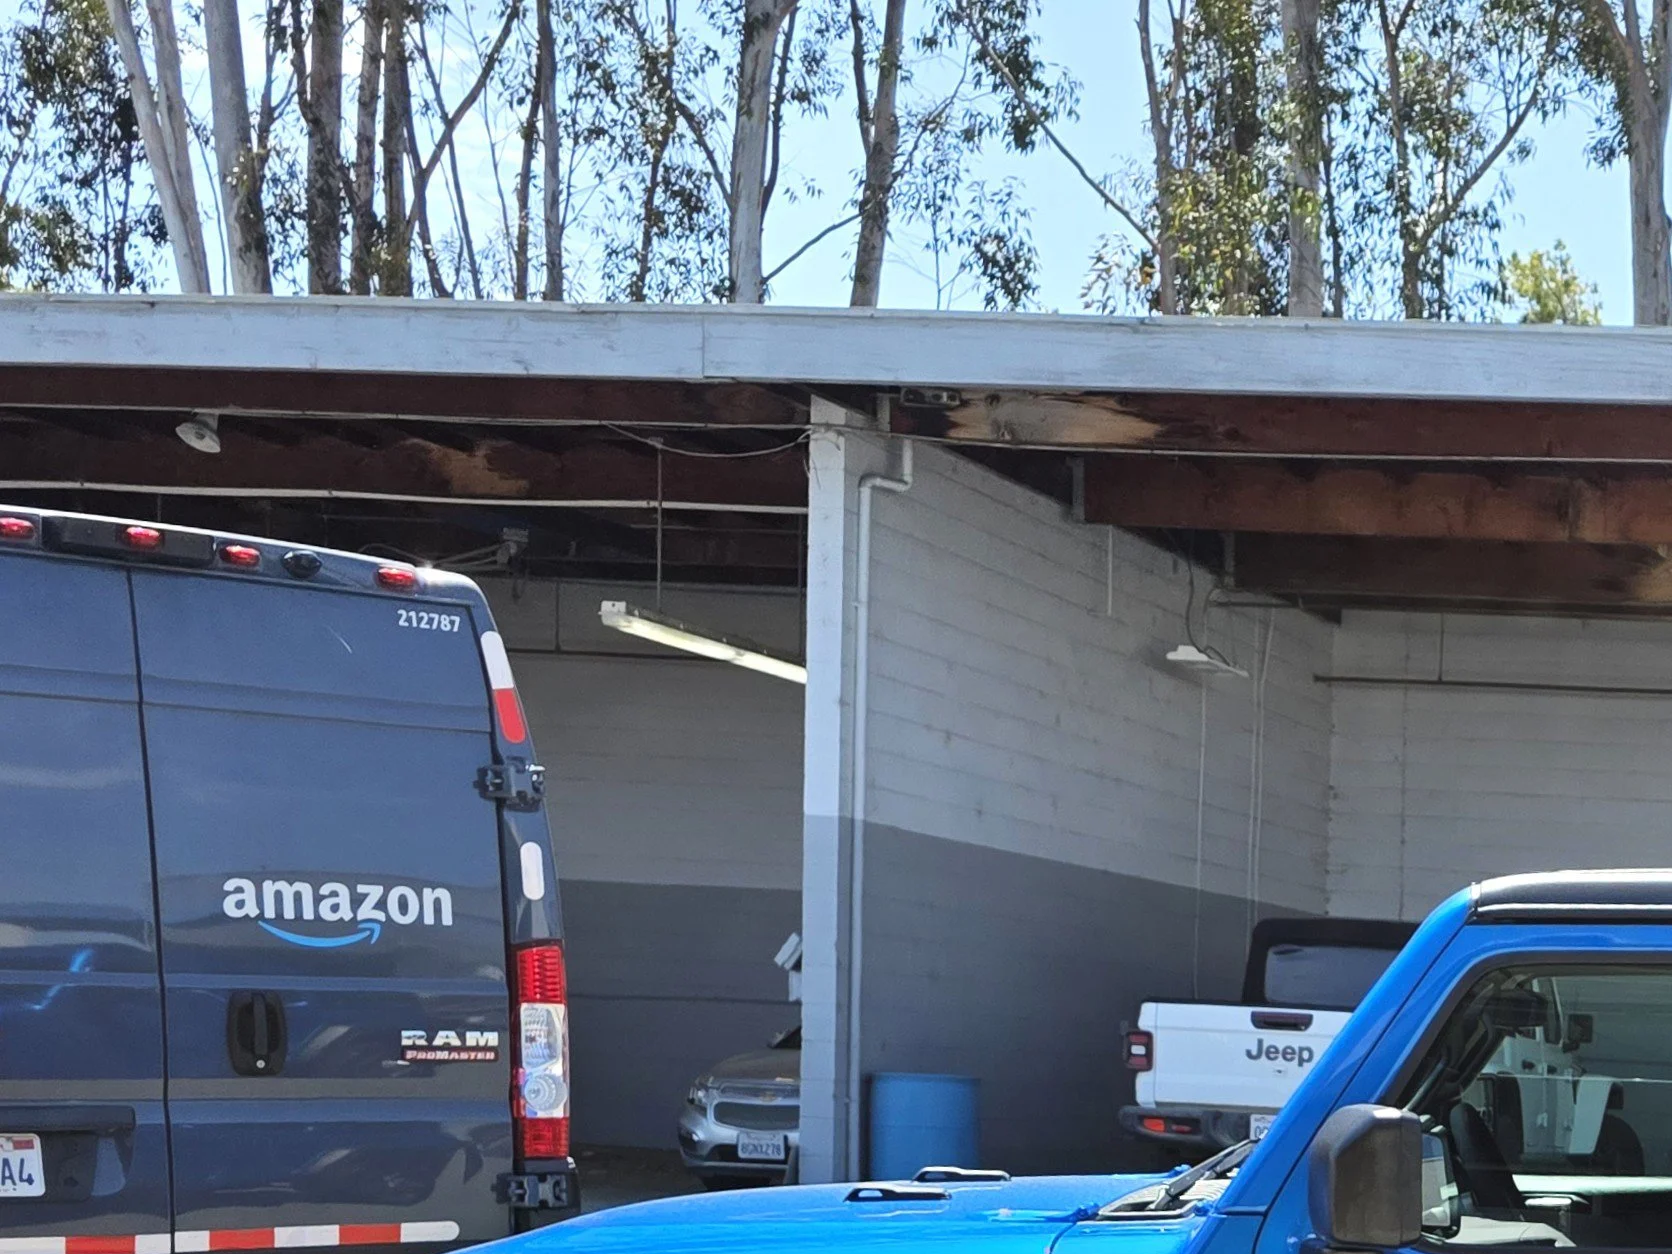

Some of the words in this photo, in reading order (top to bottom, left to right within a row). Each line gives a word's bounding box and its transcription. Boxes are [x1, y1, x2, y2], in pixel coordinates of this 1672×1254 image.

[397, 609, 461, 633] 212787
[222, 878, 453, 927] amazon
[401, 1030, 500, 1047] RAM
[1245, 1038, 1314, 1068] Jeep
[1, 1157, 35, 1187] A4
